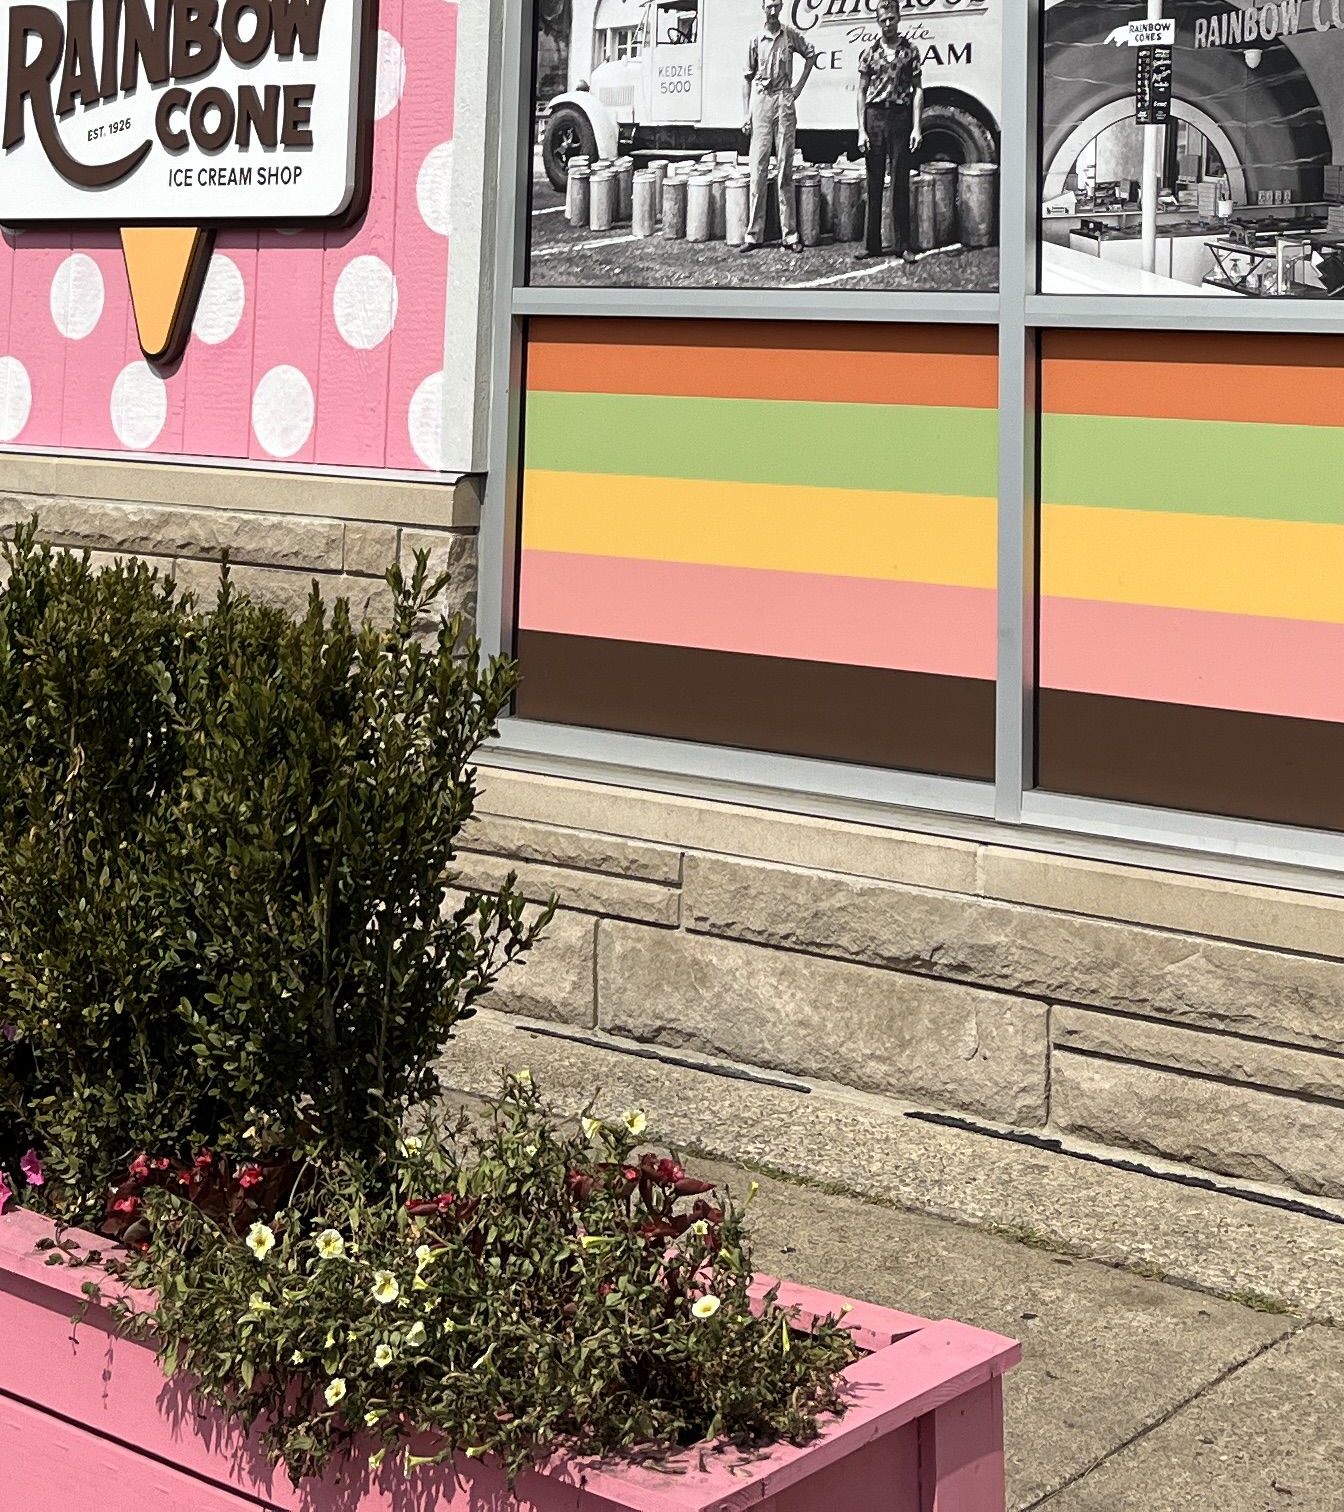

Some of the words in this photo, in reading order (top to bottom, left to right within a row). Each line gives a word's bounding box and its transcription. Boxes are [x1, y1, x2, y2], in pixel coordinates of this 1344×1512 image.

[1128, 23, 1171, 34] RAINBOW
[1134, 32, 1163, 42] CONES
[814, 49, 843, 70] CE
[658, 64, 694, 78] KEDZIE
[660, 80, 691, 94] 5000
[156, 84, 316, 153] CONE
[87, 128, 106, 143] EST.
[109, 118, 132, 135] 1926
[168, 169, 193, 188] ICE
[197, 168, 253, 187] CREAM
[256, 167, 303, 186] SHOP
